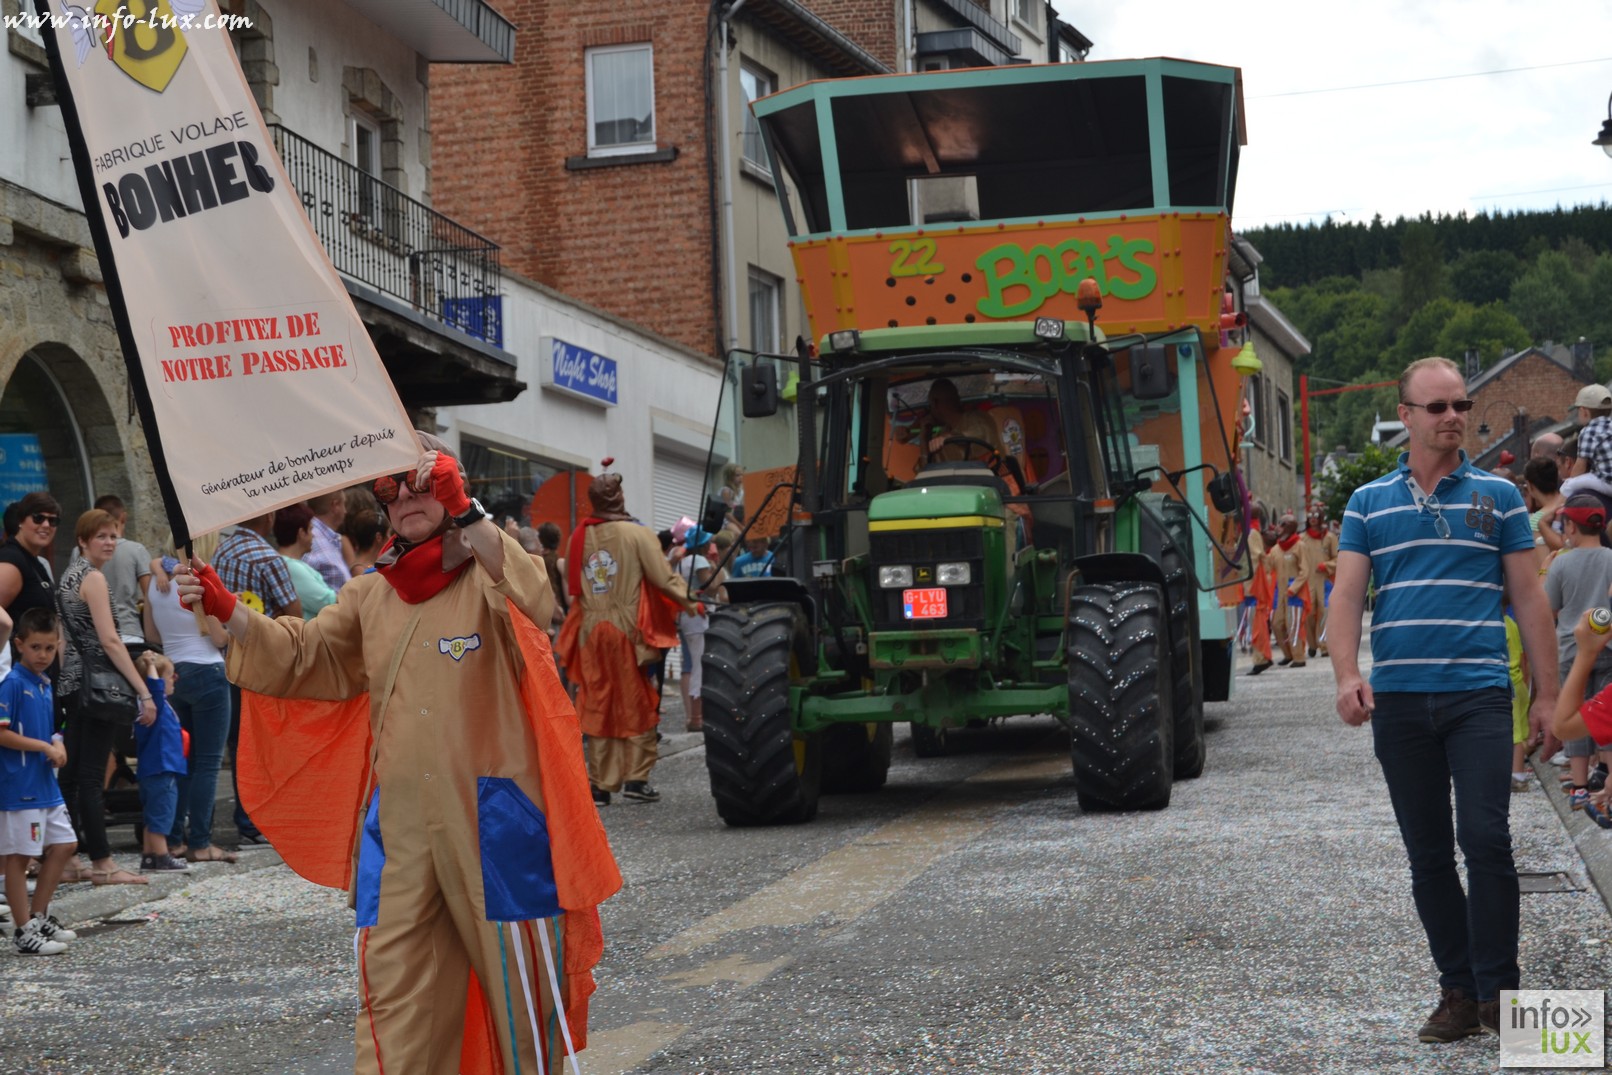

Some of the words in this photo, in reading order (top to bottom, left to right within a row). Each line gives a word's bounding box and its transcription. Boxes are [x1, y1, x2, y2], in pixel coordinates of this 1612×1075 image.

[95, 134, 165, 174] FABRIQUE
[888, 238, 945, 277] 22
[168, 317, 282, 348] PROFITEZ
[286, 312, 321, 338] DE
[161, 353, 233, 382] NOTRE
[241, 344, 347, 375] PASSAGE
[553, 341, 586, 388] Night
[588, 357, 616, 397] Shop
[201, 467, 265, 496] Générateur
[268, 461, 286, 475] de
[286, 442, 347, 468] bonheur
[350, 428, 395, 449] depuis
[242, 487, 260, 498] la
[262, 476, 290, 493] nuit
[292, 470, 314, 483] des
[314, 457, 355, 477] temps
[1471, 490, 1495, 513] 19
[1465, 508, 1496, 534] 68
[921, 603, 945, 615] 463
